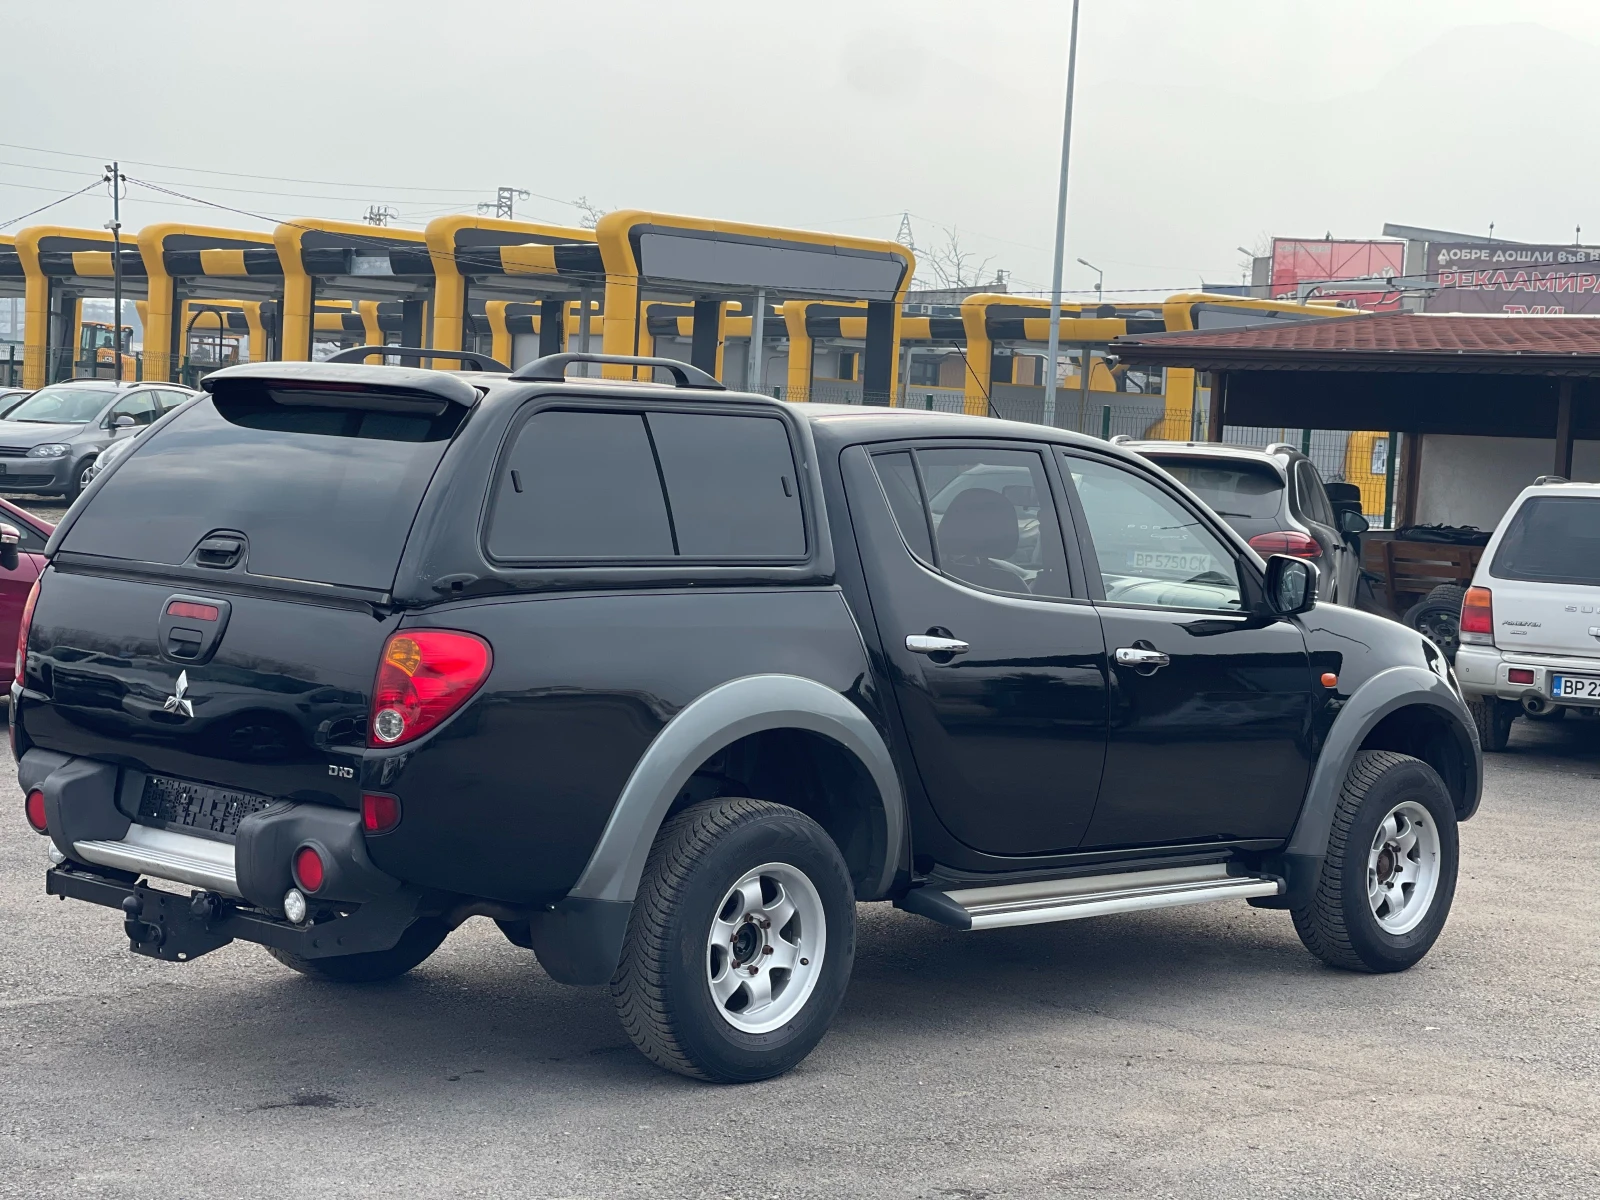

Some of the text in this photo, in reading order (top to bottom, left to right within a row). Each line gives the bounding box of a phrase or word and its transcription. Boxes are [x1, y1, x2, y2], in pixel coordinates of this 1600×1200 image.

[1438, 249, 1490, 262] ДОБРЕ
[1493, 250, 1553, 262] ДОШЛИ
[1136, 553, 1208, 571] BP 5750 CK
[1563, 679, 1600, 697] BP 2
